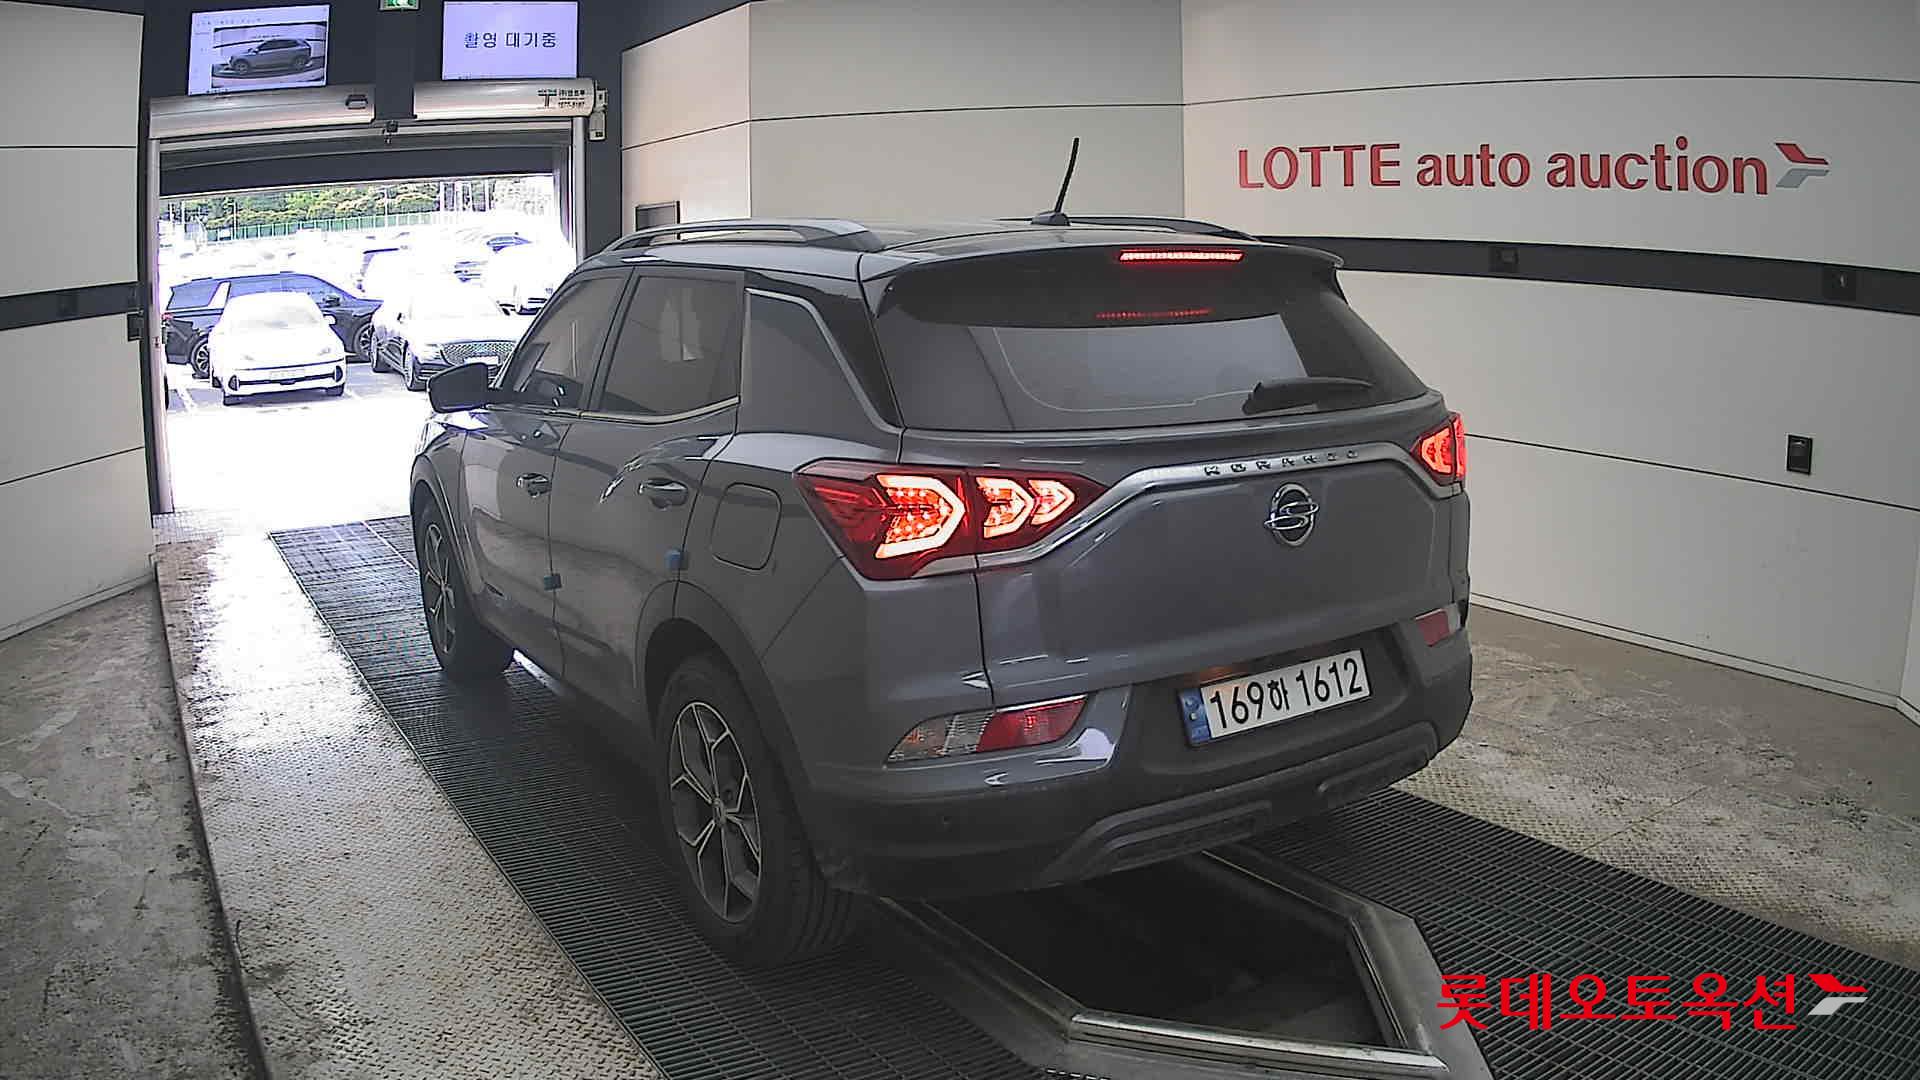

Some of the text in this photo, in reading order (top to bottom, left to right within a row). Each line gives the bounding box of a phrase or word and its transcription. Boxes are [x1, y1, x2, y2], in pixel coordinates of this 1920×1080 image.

[464, 32, 556, 49] 촬영 대기중
[1238, 135, 1769, 195] LOTTE auto auction
[1209, 657, 1363, 729] 169하 1612
